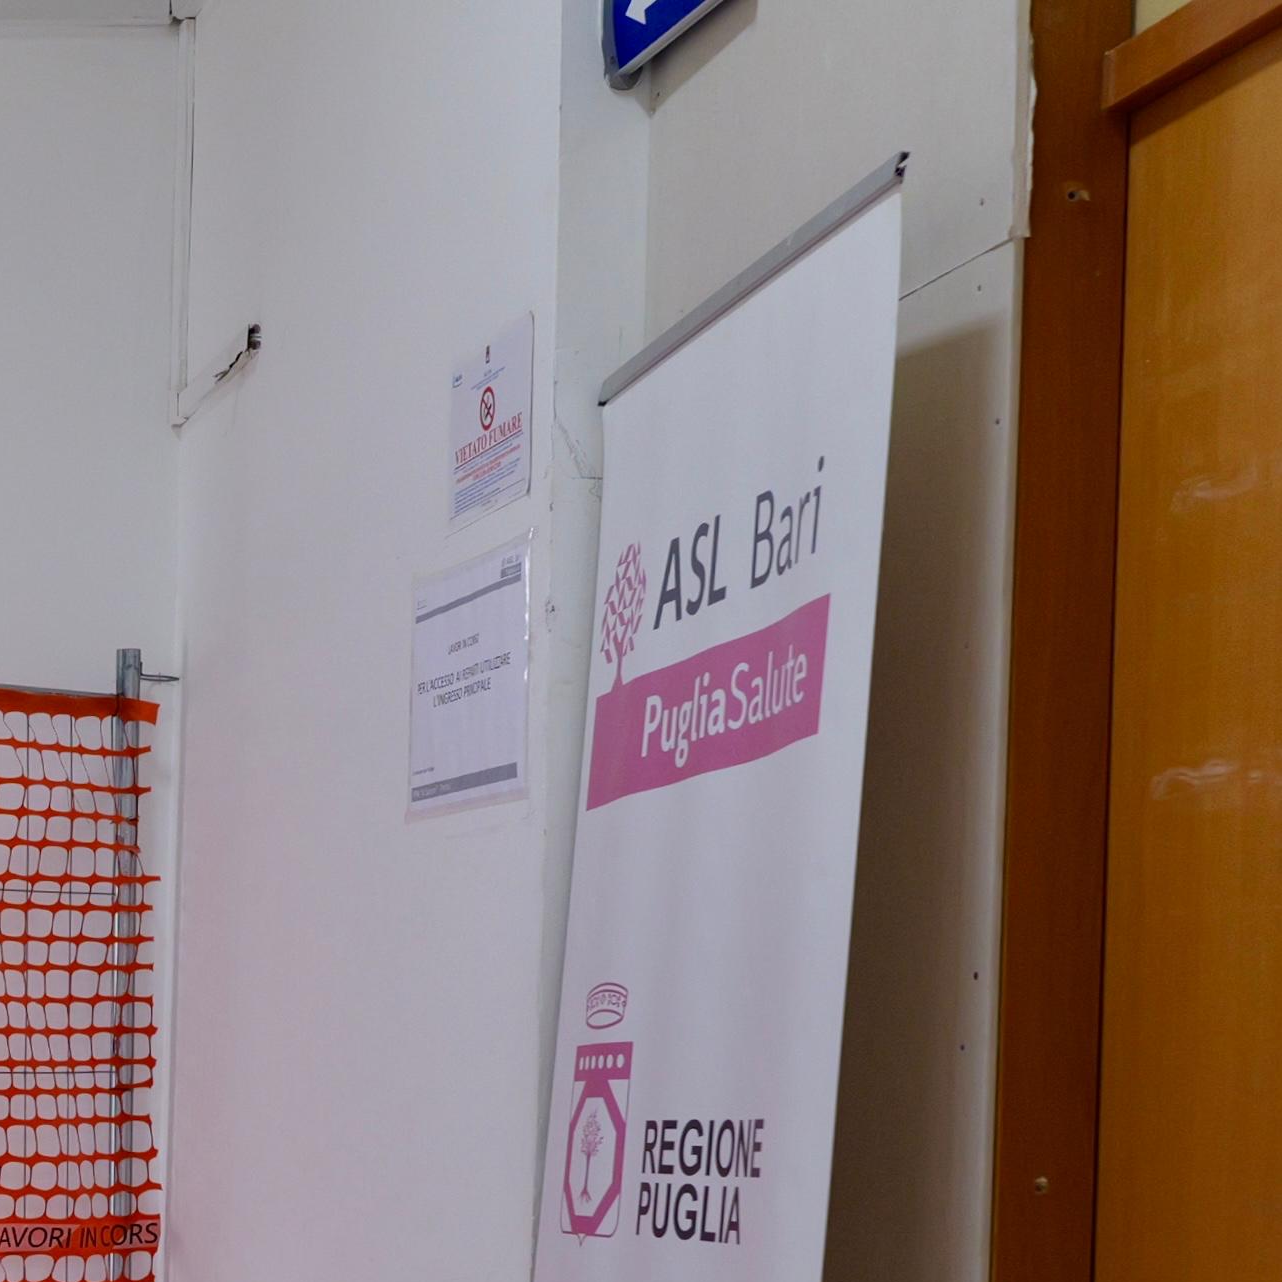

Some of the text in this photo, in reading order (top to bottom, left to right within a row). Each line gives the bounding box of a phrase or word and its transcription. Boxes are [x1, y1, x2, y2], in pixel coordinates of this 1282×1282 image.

[653, 456, 824, 630] ASL Bari
[641, 644, 807, 768] PugliaSalute
[642, 1118, 764, 1178] REGIONE
[80, 1227, 97, 1248] IN
[636, 1182, 740, 1245] PUGLIA
